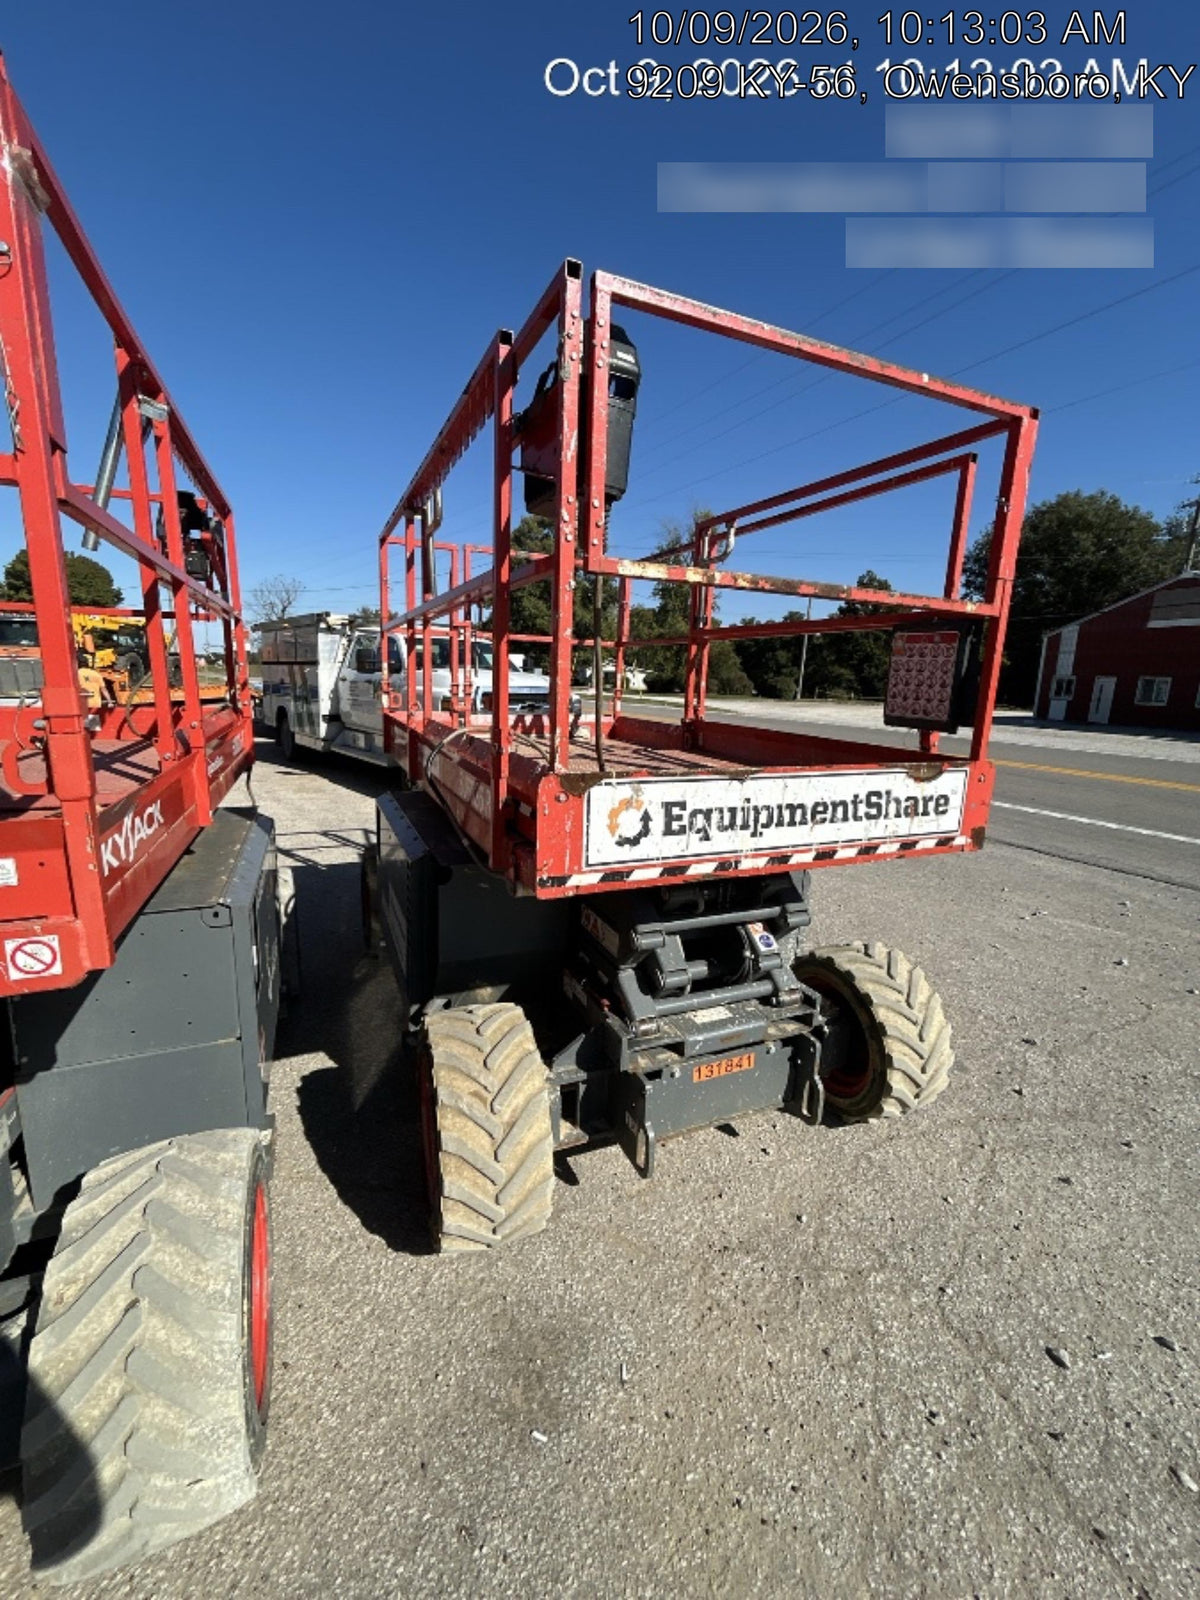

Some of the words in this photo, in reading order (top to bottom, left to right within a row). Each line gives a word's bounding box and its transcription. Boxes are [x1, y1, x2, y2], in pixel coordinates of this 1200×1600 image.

[100, 799, 165, 877] KYJACK
[661, 789, 950, 841] EquipmentShare
[694, 1053, 752, 1080] 131841
